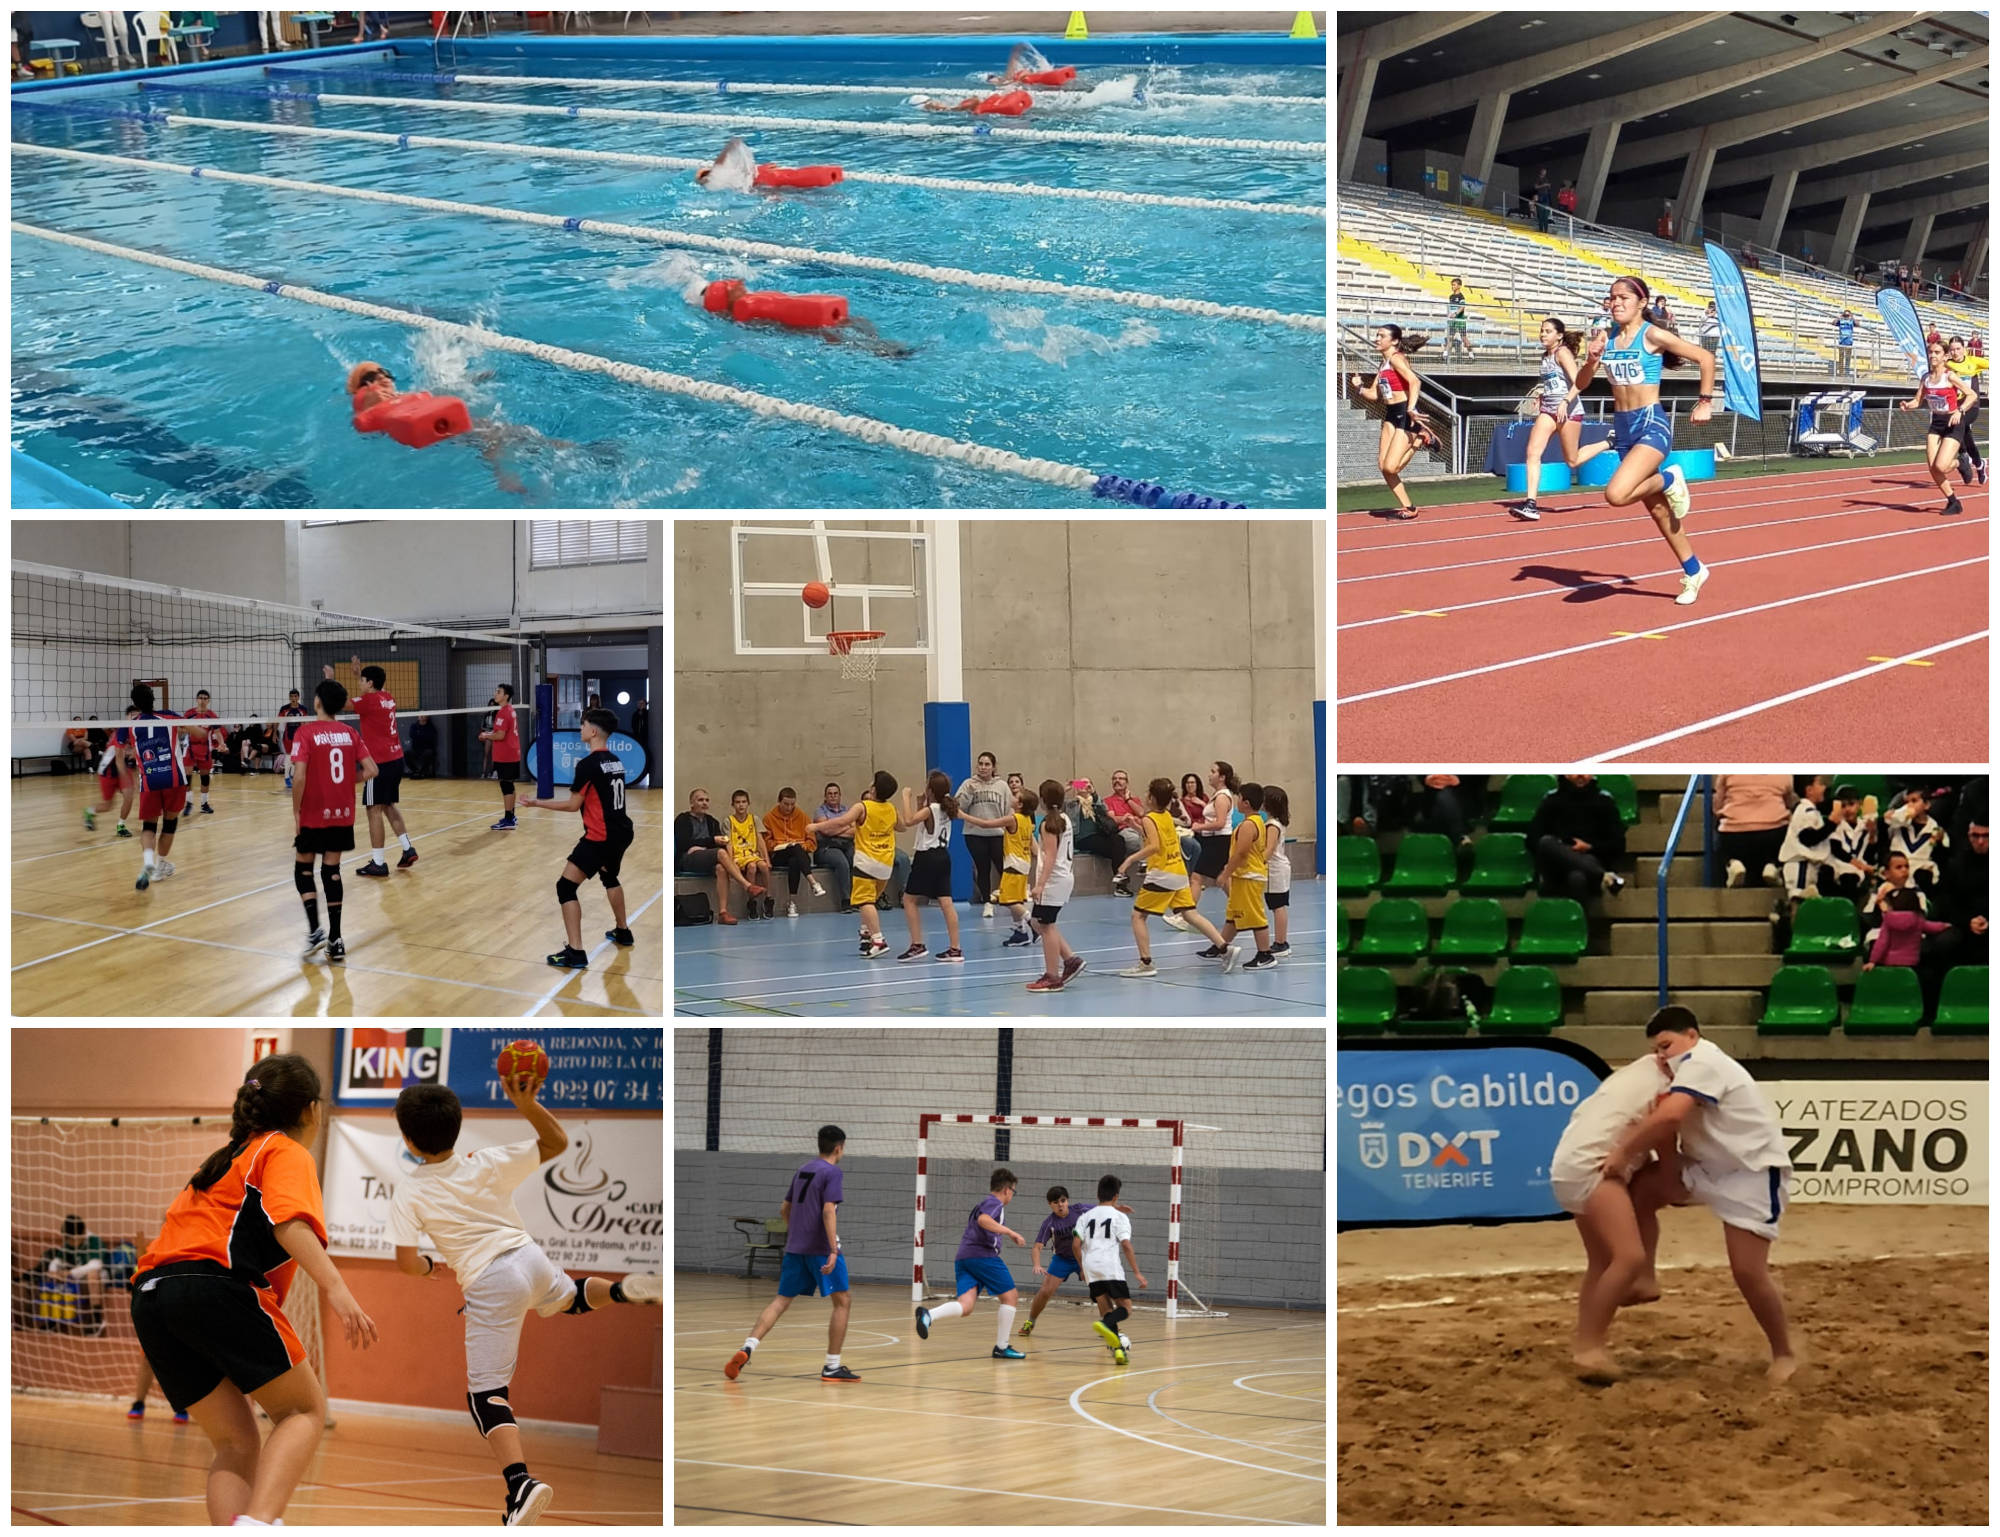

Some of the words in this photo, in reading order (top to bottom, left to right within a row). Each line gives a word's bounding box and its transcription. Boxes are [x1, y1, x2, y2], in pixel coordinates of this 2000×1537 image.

[329, 747, 344, 784] 8
[610, 778, 624, 810] 10
[353, 1046, 438, 1079] KING
[590, 1055, 613, 1069] DE
[616, 1055, 637, 1069] LA
[553, 1080, 589, 1101] 922
[593, 1080, 618, 1101] 07
[624, 1080, 650, 1101] 34
[1430, 1072, 1580, 1109] Cabildo
[1775, 1100, 1793, 1119] Y
[1799, 1099, 1968, 1121] ATEZADOS
[1398, 1130, 1501, 1168] DXT
[1781, 1127, 1968, 1173] ZANO
[797, 1171, 816, 1204] 7
[1403, 1171, 1495, 1189] TENERIFE
[1789, 1177, 1969, 1196] COMPROMISO
[568, 1202, 663, 1237] Drea
[1086, 1218, 1112, 1239] 11
